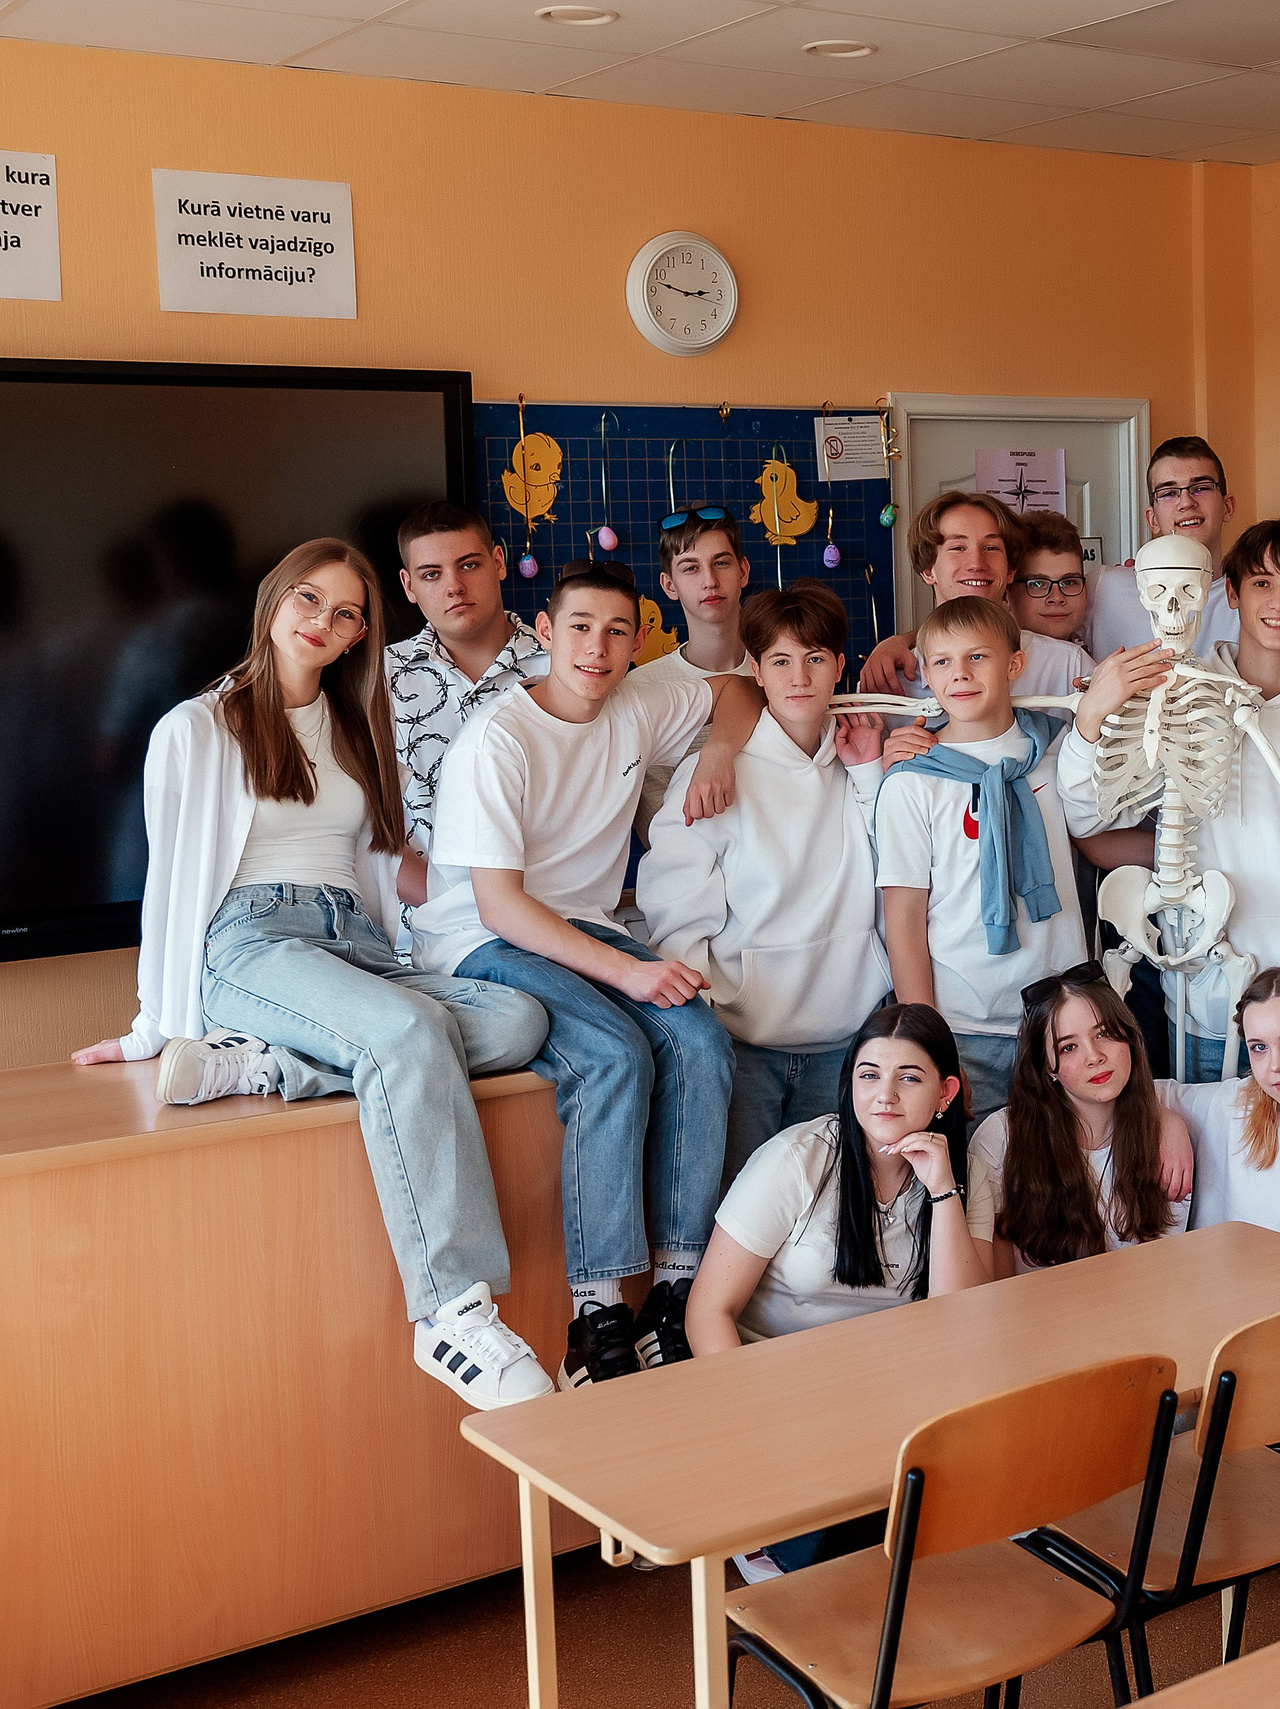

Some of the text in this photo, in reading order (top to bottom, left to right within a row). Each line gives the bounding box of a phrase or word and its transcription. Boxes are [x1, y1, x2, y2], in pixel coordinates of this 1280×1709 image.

[6, 165, 51, 186] kura
[0, 200, 42, 217] tver
[177, 198, 331, 224] Kurā vietnē varu
[0, 231, 21, 251] ja
[178, 231, 335, 257] meklēt vajadzīgo
[667, 257, 676, 268] 11
[681, 252, 692, 264] 12
[701, 259, 705, 270] 1
[200, 261, 316, 286] informāciju?
[655, 269, 666, 280] 10
[711, 272, 718, 283] 2
[650, 286, 657, 297] 9
[717, 289, 723, 301] 3
[656, 305, 662, 317] 8
[711, 308, 717, 319] 4
[670, 318, 676, 330] 7
[684, 323, 691, 335] 6
[701, 320, 707, 331] 5
[458, 1299, 482, 1316] adidas
